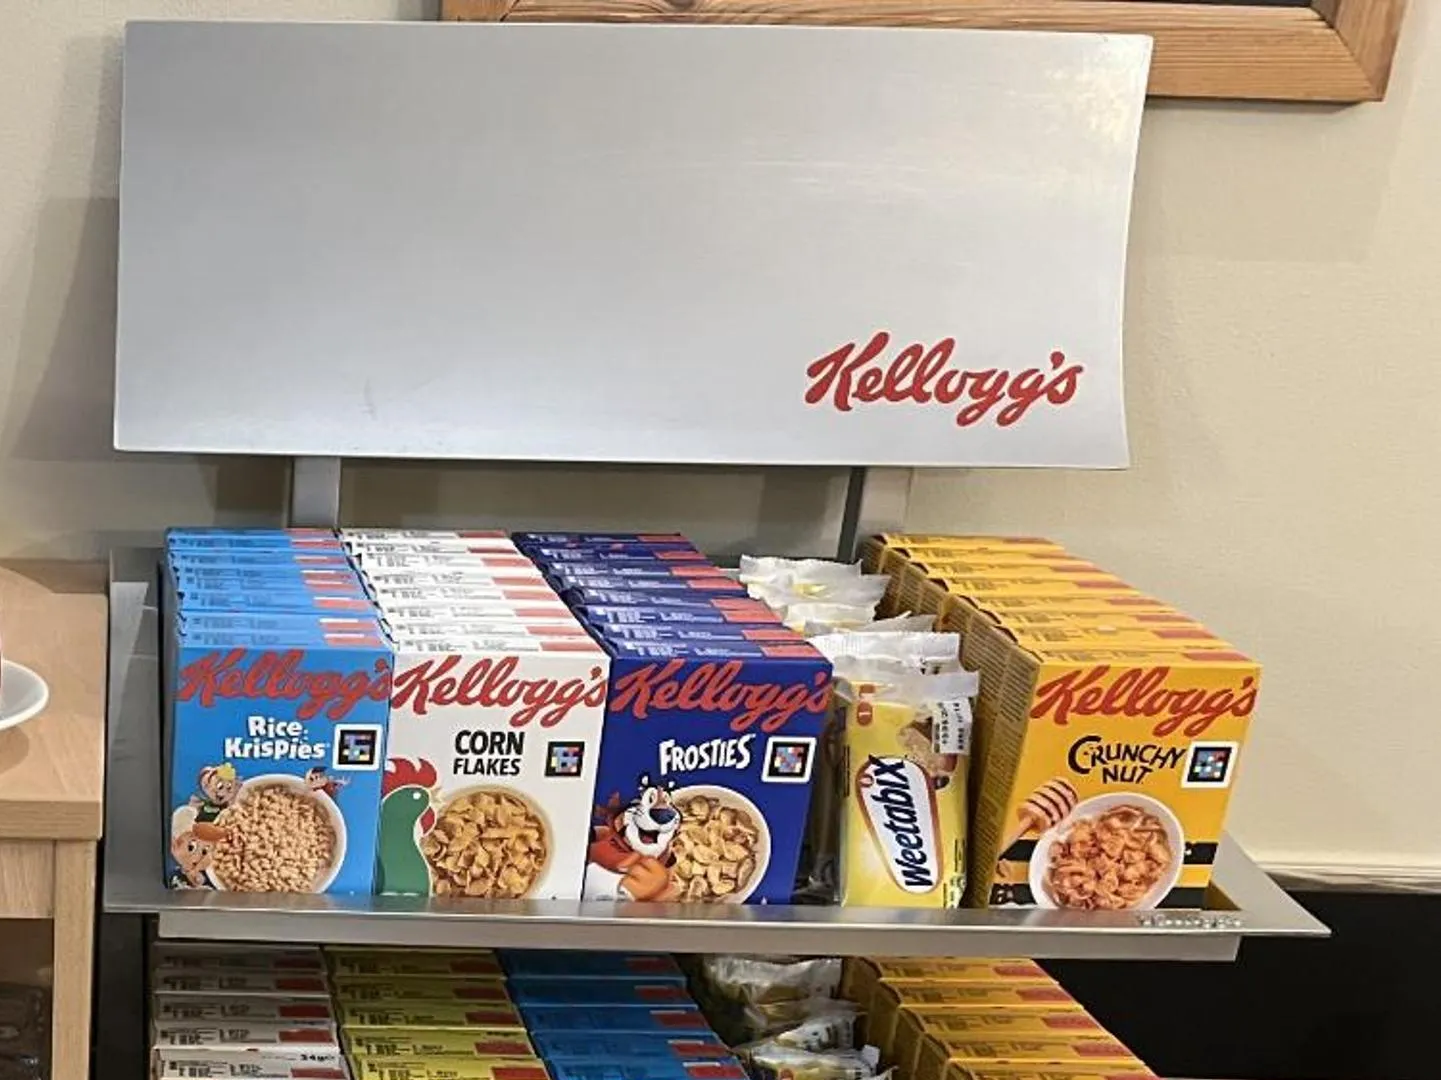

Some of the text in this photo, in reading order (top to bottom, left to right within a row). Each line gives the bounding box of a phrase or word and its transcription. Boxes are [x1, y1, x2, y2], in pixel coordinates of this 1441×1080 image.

[804, 331, 1084, 427] Kellogg's
[176, 647, 392, 720] Kellogg's
[391, 655, 608, 727] Kellogg's
[611, 659, 832, 731] Kellogg's
[1030, 664, 1258, 737] Kellogg's
[248, 716, 303, 737] Rice
[454, 729, 525, 755] CORN
[224, 738, 326, 760] Krispies
[453, 759, 520, 776] FLAKES
[659, 735, 753, 775] FROSTIES
[1068, 735, 1186, 774] CRUNCHY
[1102, 766, 1154, 784] NUT
[868, 754, 933, 888] Weetabix
